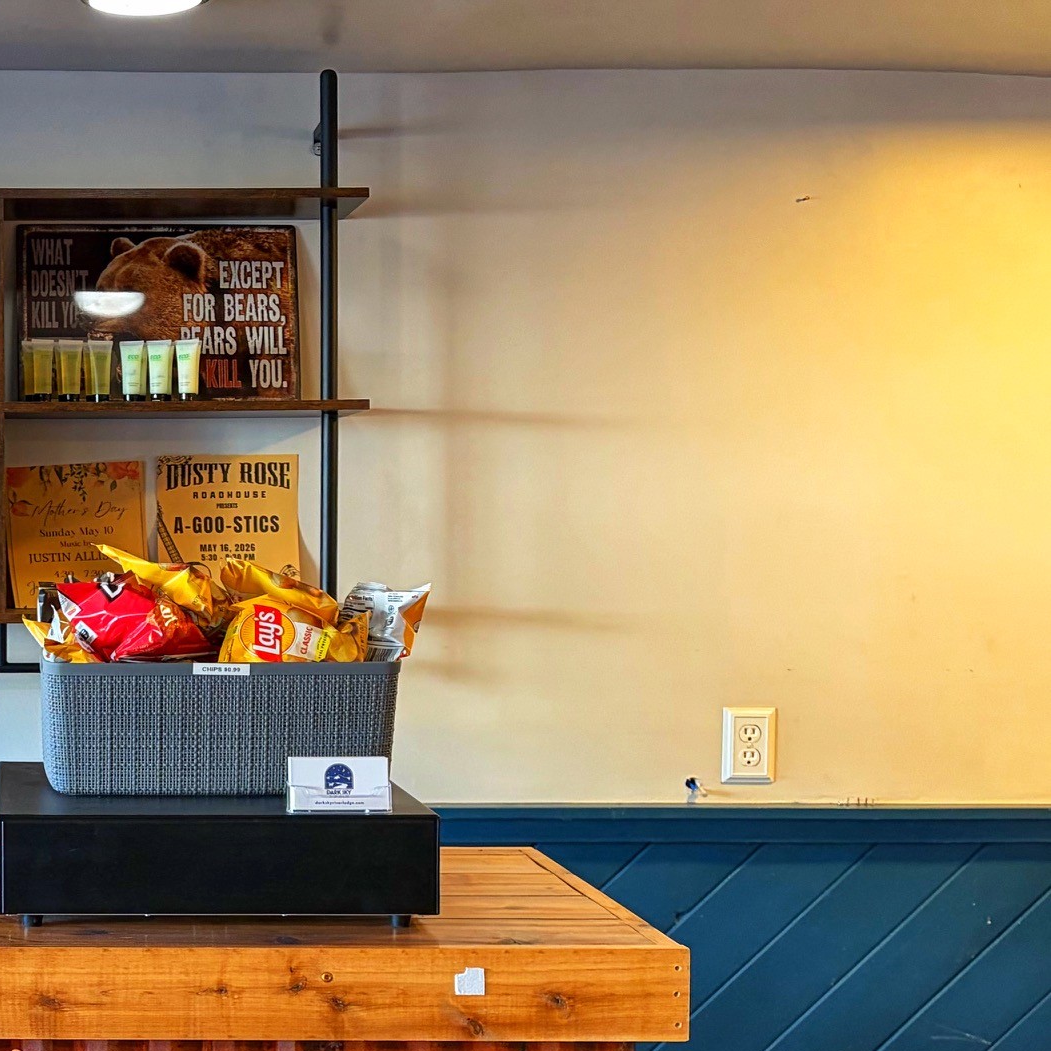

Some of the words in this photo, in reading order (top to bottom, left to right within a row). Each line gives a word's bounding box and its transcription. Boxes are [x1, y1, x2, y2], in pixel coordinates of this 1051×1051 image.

[31, 239, 73, 265] WHAT
[31, 270, 89, 297] DOESN'T
[219, 261, 284, 289] EXCEPT
[31, 301, 59, 328] KILL
[62, 301, 81, 328] YO
[183, 294, 216, 322] FOR
[223, 294, 286, 325] BEARS,
[245, 326, 287, 355] WILL
[206, 359, 242, 388] KILL
[249, 359, 287, 388] YOU.
[166, 460, 232, 491] DUSTY
[239, 462, 290, 489] ROSE
[192, 490, 267, 499] ROADHOUSE
[31, 499, 89, 526] Mother's
[94, 501, 128, 520] Day
[173, 514, 280, 534] A-GOO-STICS
[39, 528, 76, 538] Sunday
[79, 526, 100, 537] May
[103, 525, 114, 535] 10
[59, 540, 81, 548] Music
[28, 552, 71, 564] JUSTIN
[200, 544, 217, 552] MAY
[219, 543, 232, 553] 16,
[234, 543, 256, 552] 2026
[244, 553, 255, 561] PM
[252, 611, 284, 655] Lay's
[300, 626, 313, 654] CLASSIC
